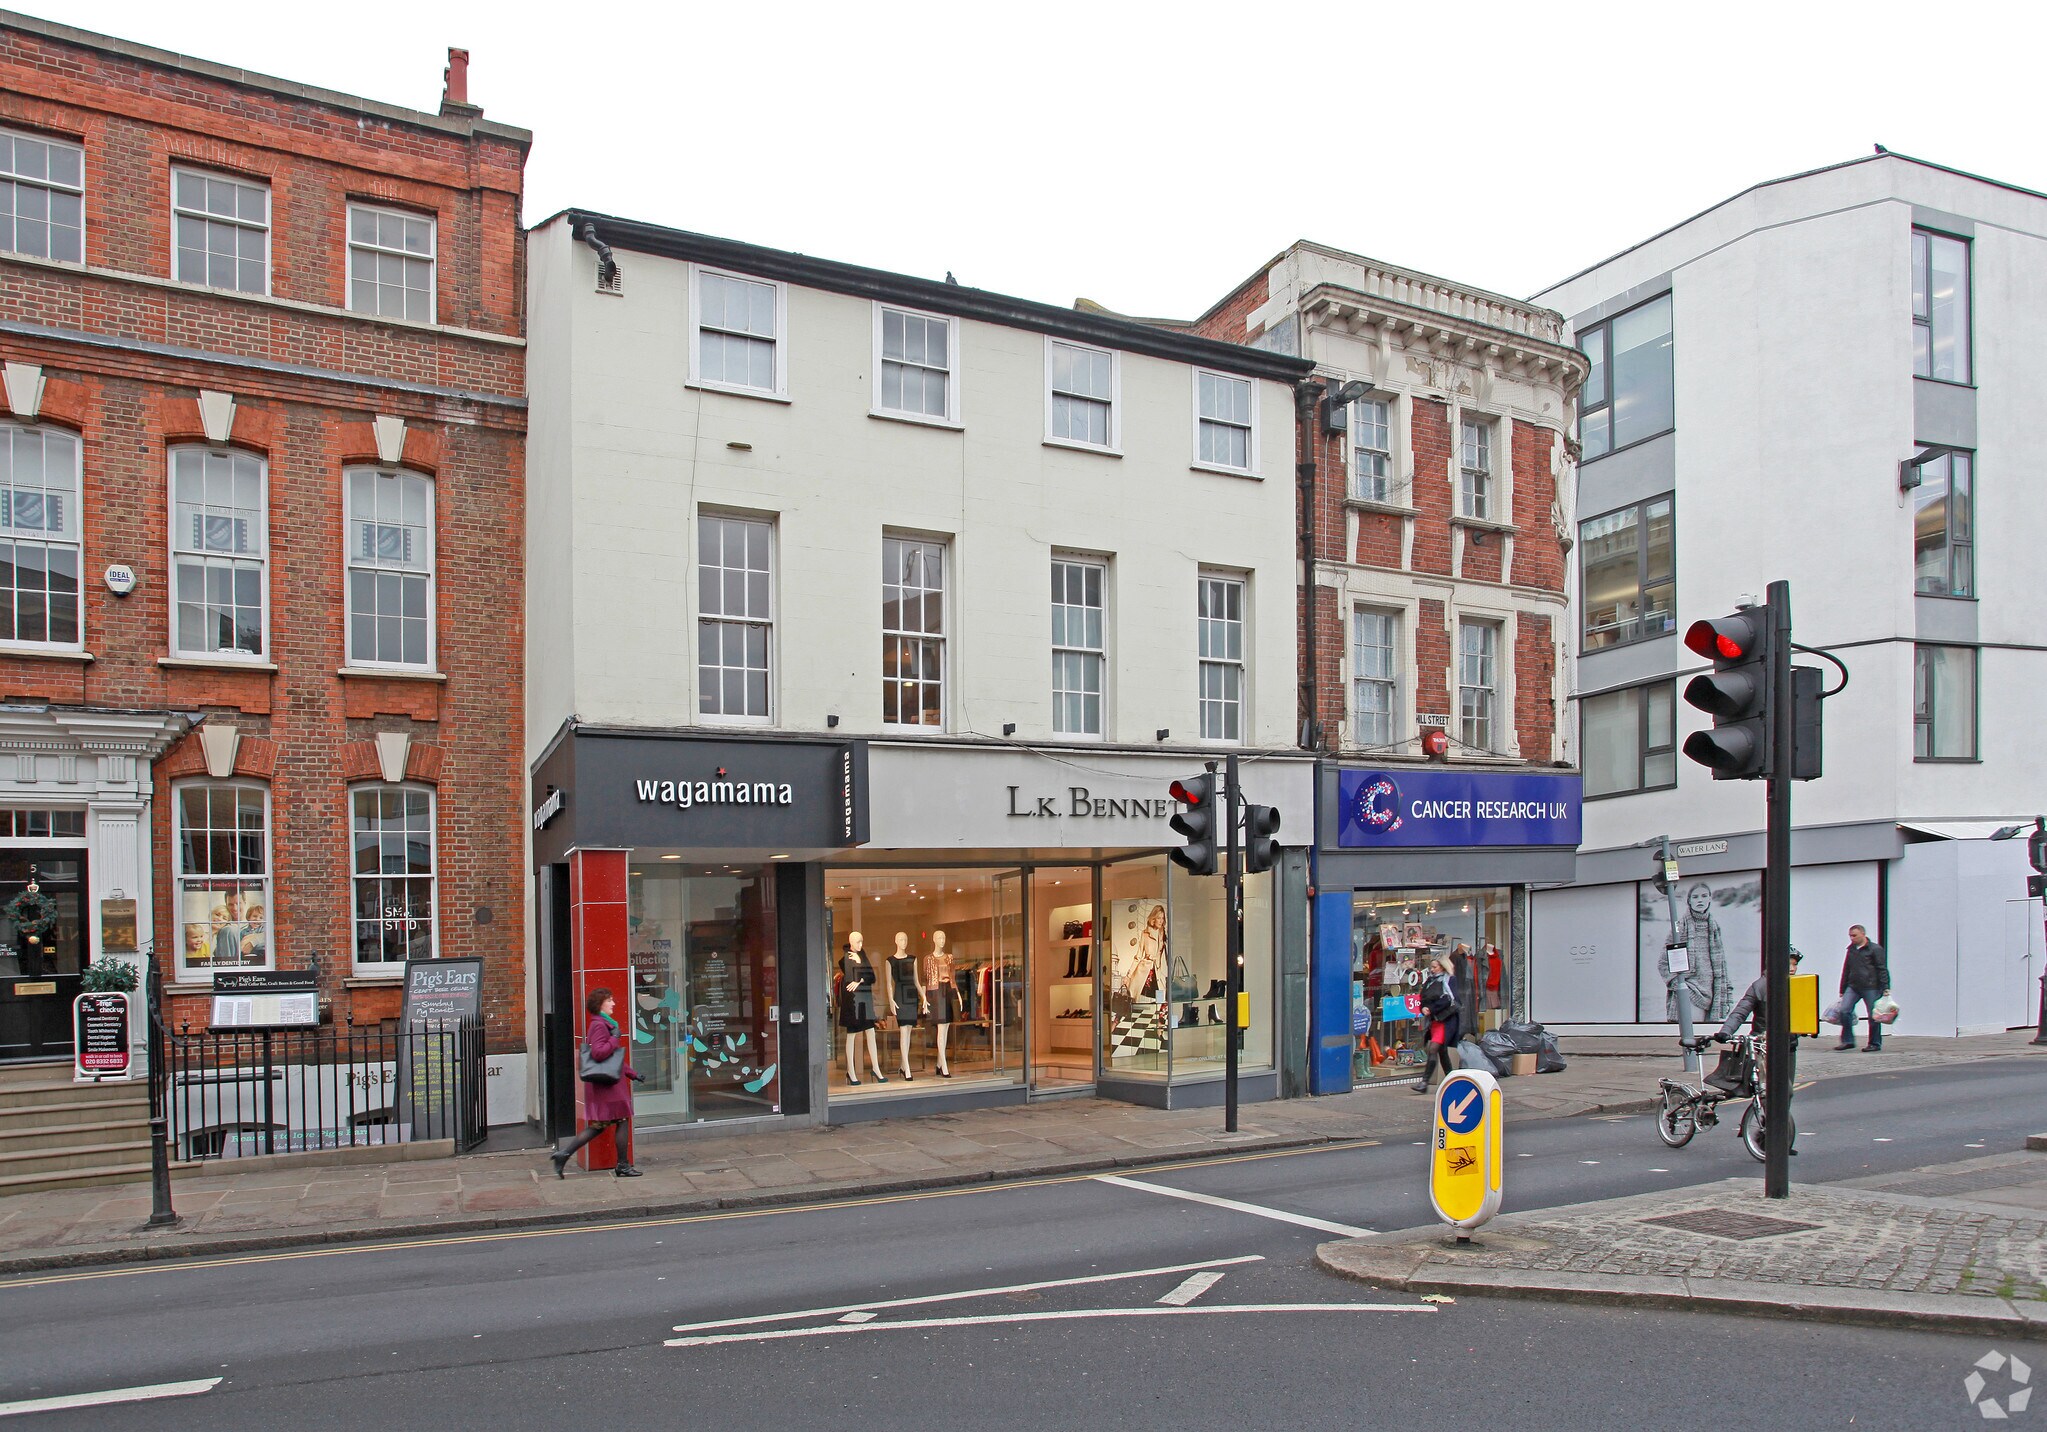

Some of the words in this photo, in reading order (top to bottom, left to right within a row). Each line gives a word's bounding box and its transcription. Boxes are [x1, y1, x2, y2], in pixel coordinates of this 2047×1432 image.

[1416, 715, 1427, 724] HILL
[1428, 715, 1450, 725] STREET
[636, 778, 793, 808] wagamama
[843, 751, 852, 838] wagamama
[1411, 800, 1471, 819] CANCER
[1477, 801, 1546, 819] RESEARCH
[1550, 802, 1567, 819] UK
[1679, 845, 1704, 854] WATER
[1705, 842, 1726, 852] LANE
[30, 864, 37, 873] 5
[1569, 945, 1596, 956] COS
[238, 976, 252, 984] Pig's
[412, 971, 443, 989] Pig's
[445, 969, 476, 985] Ears
[1408, 998, 1415, 1010] 3
[345, 1071, 379, 1090] Pig's
[231, 1134, 278, 1143] Reasos
[317, 1129, 343, 1139] Pigs
[1438, 1128, 1446, 1138] B
[1438, 1138, 1445, 1149] 3
